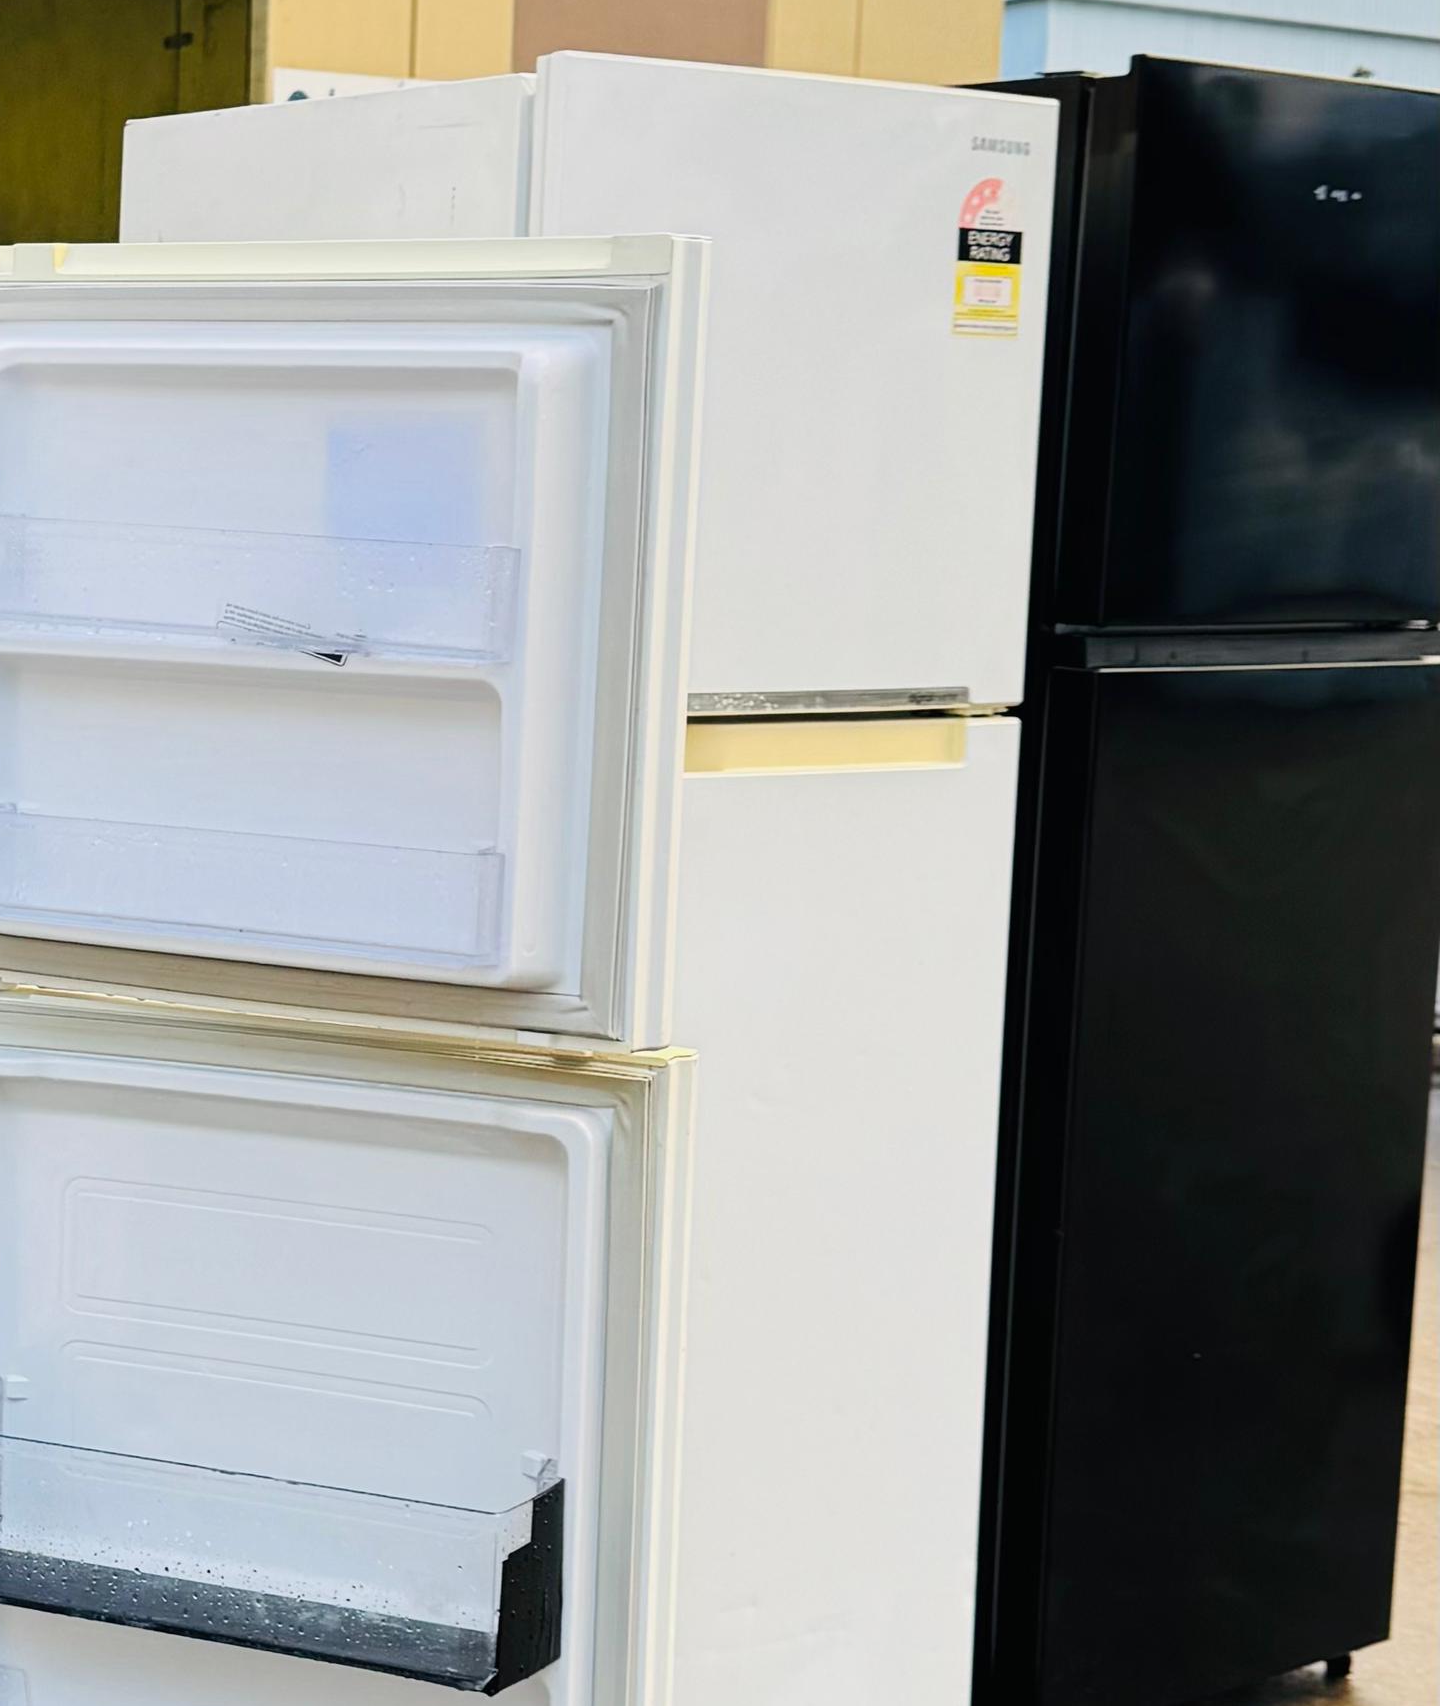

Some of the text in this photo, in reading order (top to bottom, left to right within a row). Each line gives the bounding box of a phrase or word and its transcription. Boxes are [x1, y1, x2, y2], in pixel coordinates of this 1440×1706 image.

[971, 137, 1030, 155] SAMSUNG
[968, 231, 1015, 247] ENERGY
[969, 246, 1011, 262] RATING
